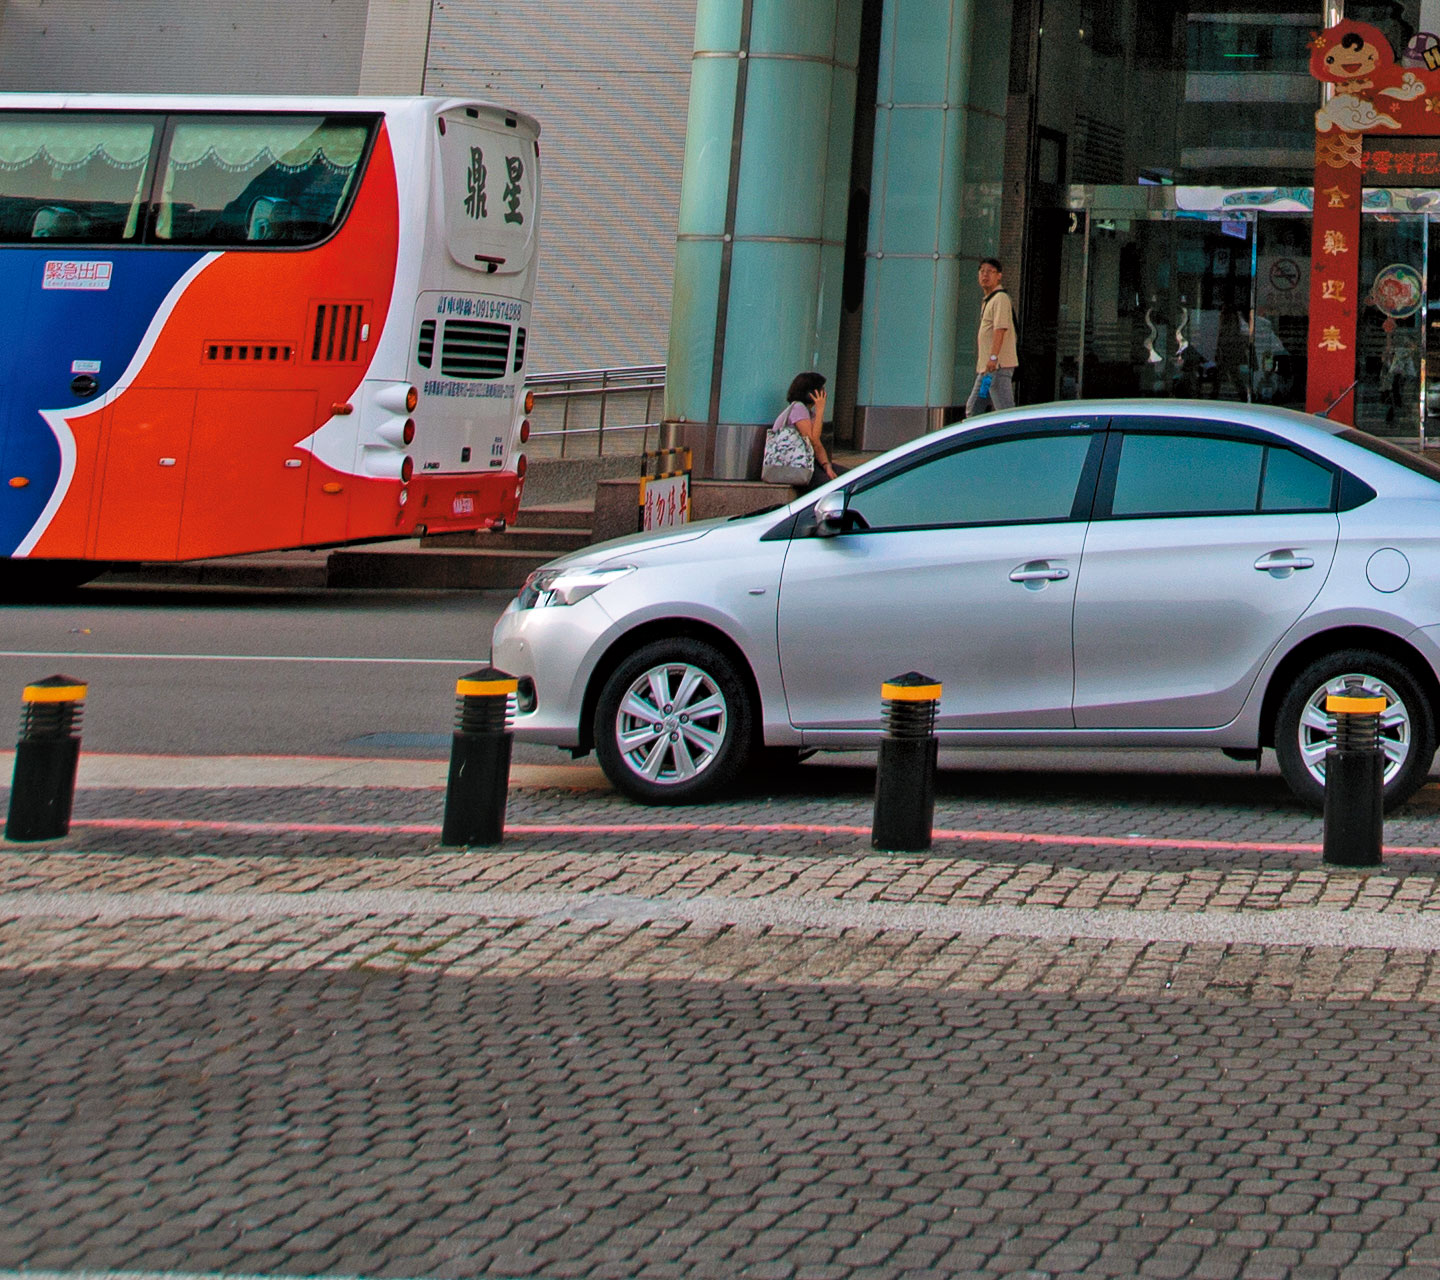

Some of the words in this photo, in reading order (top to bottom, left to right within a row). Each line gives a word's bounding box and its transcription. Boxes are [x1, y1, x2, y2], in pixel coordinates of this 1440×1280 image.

[464, 146, 524, 225] 鼎星
[46, 262, 111, 280] 緊急出口
[644, 480, 687, 530] 請勿停車
